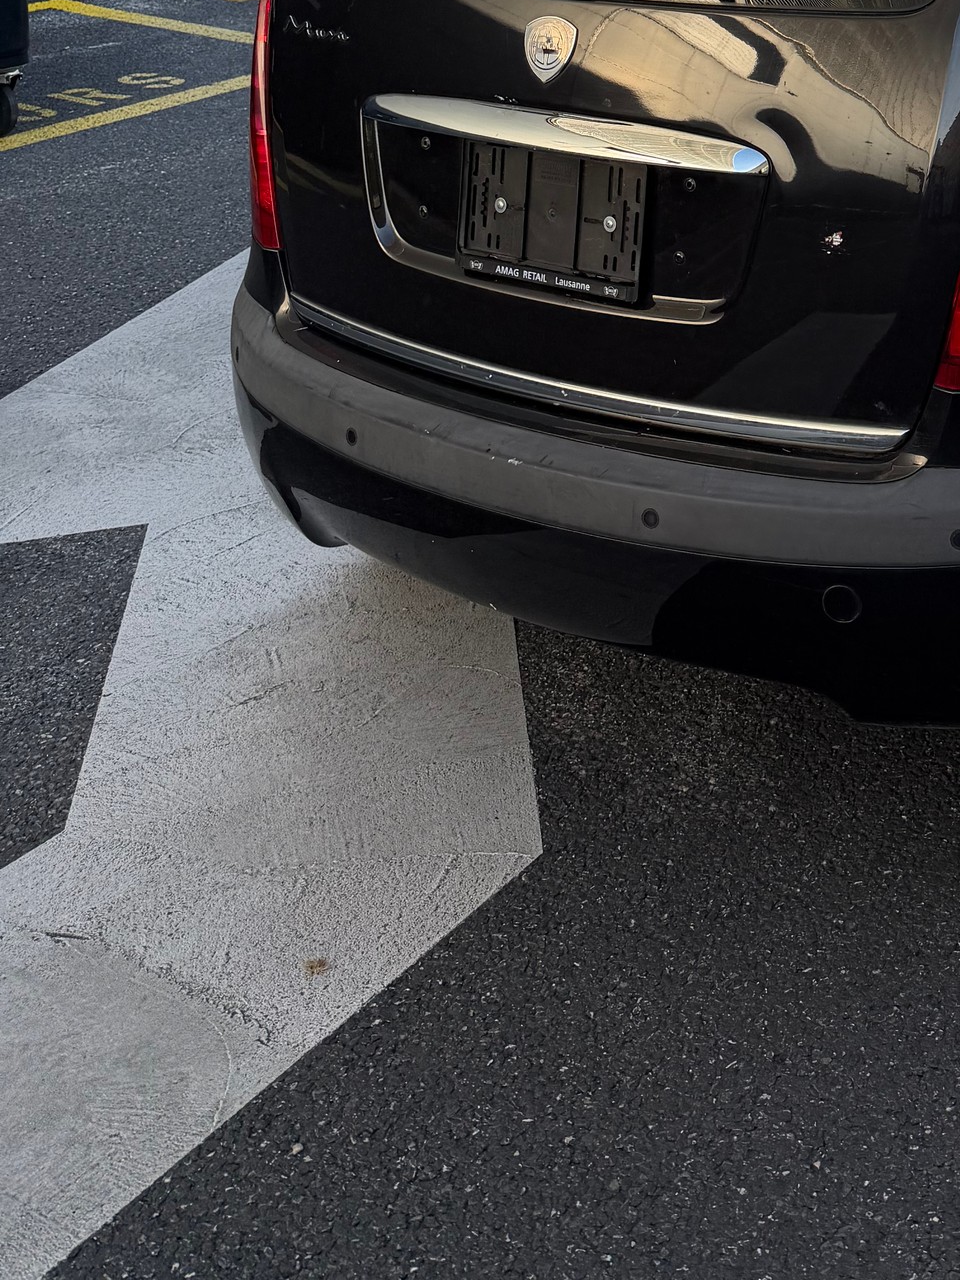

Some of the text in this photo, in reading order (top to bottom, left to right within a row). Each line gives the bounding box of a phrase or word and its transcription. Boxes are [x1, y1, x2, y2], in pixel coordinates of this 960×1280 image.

[495, 265, 519, 278] AMAG
[522, 270, 547, 283] RETAIL
[555, 276, 591, 291] Lausanne
